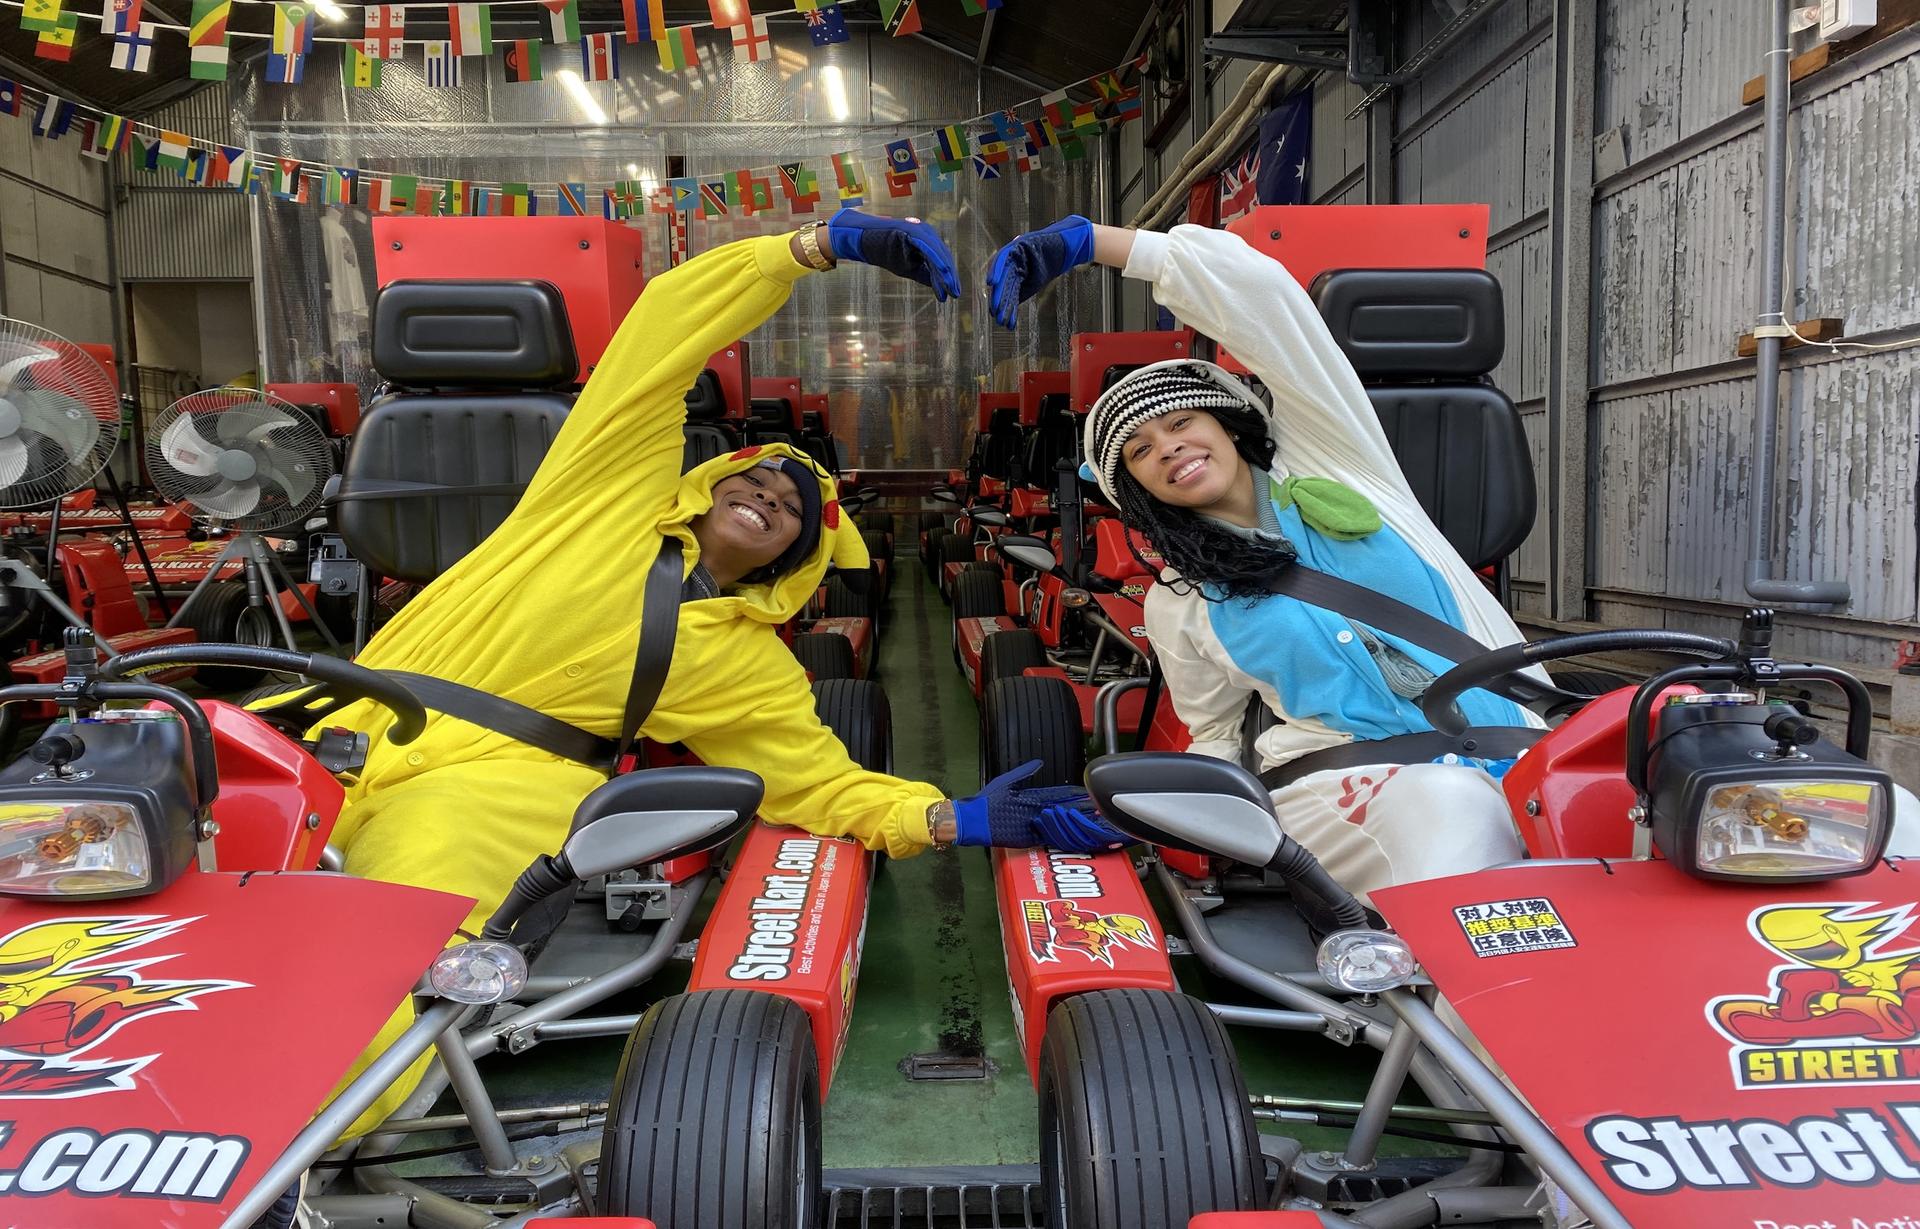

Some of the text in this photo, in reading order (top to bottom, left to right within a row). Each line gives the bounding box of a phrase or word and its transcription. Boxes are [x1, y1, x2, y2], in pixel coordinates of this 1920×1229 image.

[819, 877, 831, 893] Japan
[811, 898, 825, 913] Tours
[1459, 900, 1550, 921] 対人対物
[810, 913, 821, 925] and
[1465, 913, 1561, 937] 推奨基準
[729, 912, 800, 980] Street
[802, 922, 819, 955] Activities
[1474, 928, 1569, 950] 任意保険
[797, 954, 813, 975] Best
[1595, 1112, 1920, 1190] Street
